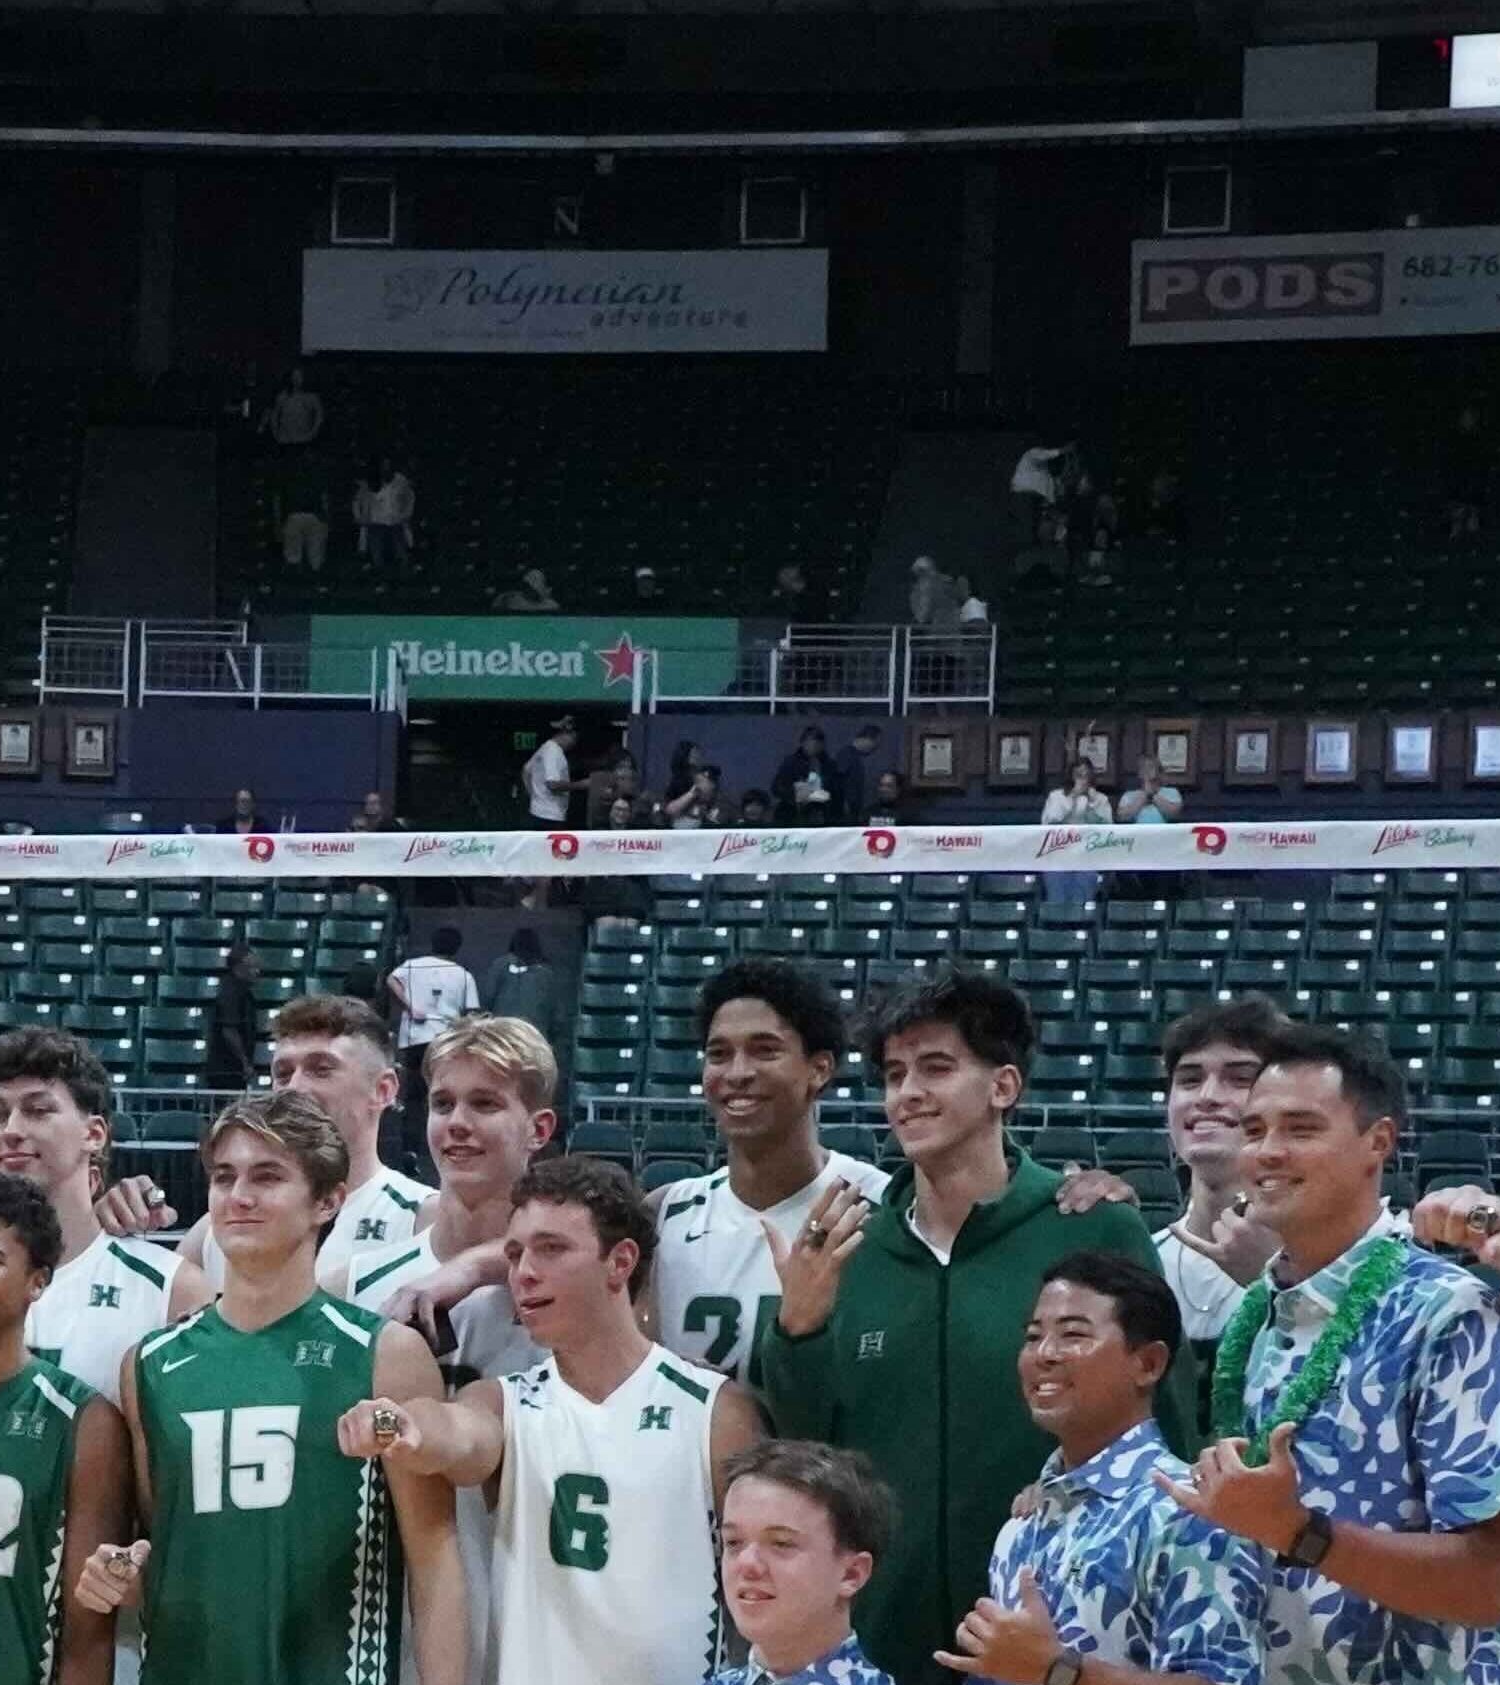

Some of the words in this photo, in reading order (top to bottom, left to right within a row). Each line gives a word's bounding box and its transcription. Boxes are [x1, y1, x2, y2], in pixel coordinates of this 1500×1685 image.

[437, 264, 684, 325] Polynesian
[1147, 261, 1379, 312] PODS
[391, 641, 586, 678] Heineken
[180, 1405, 301, 1513] 15
[549, 1472, 610, 1572] 6
